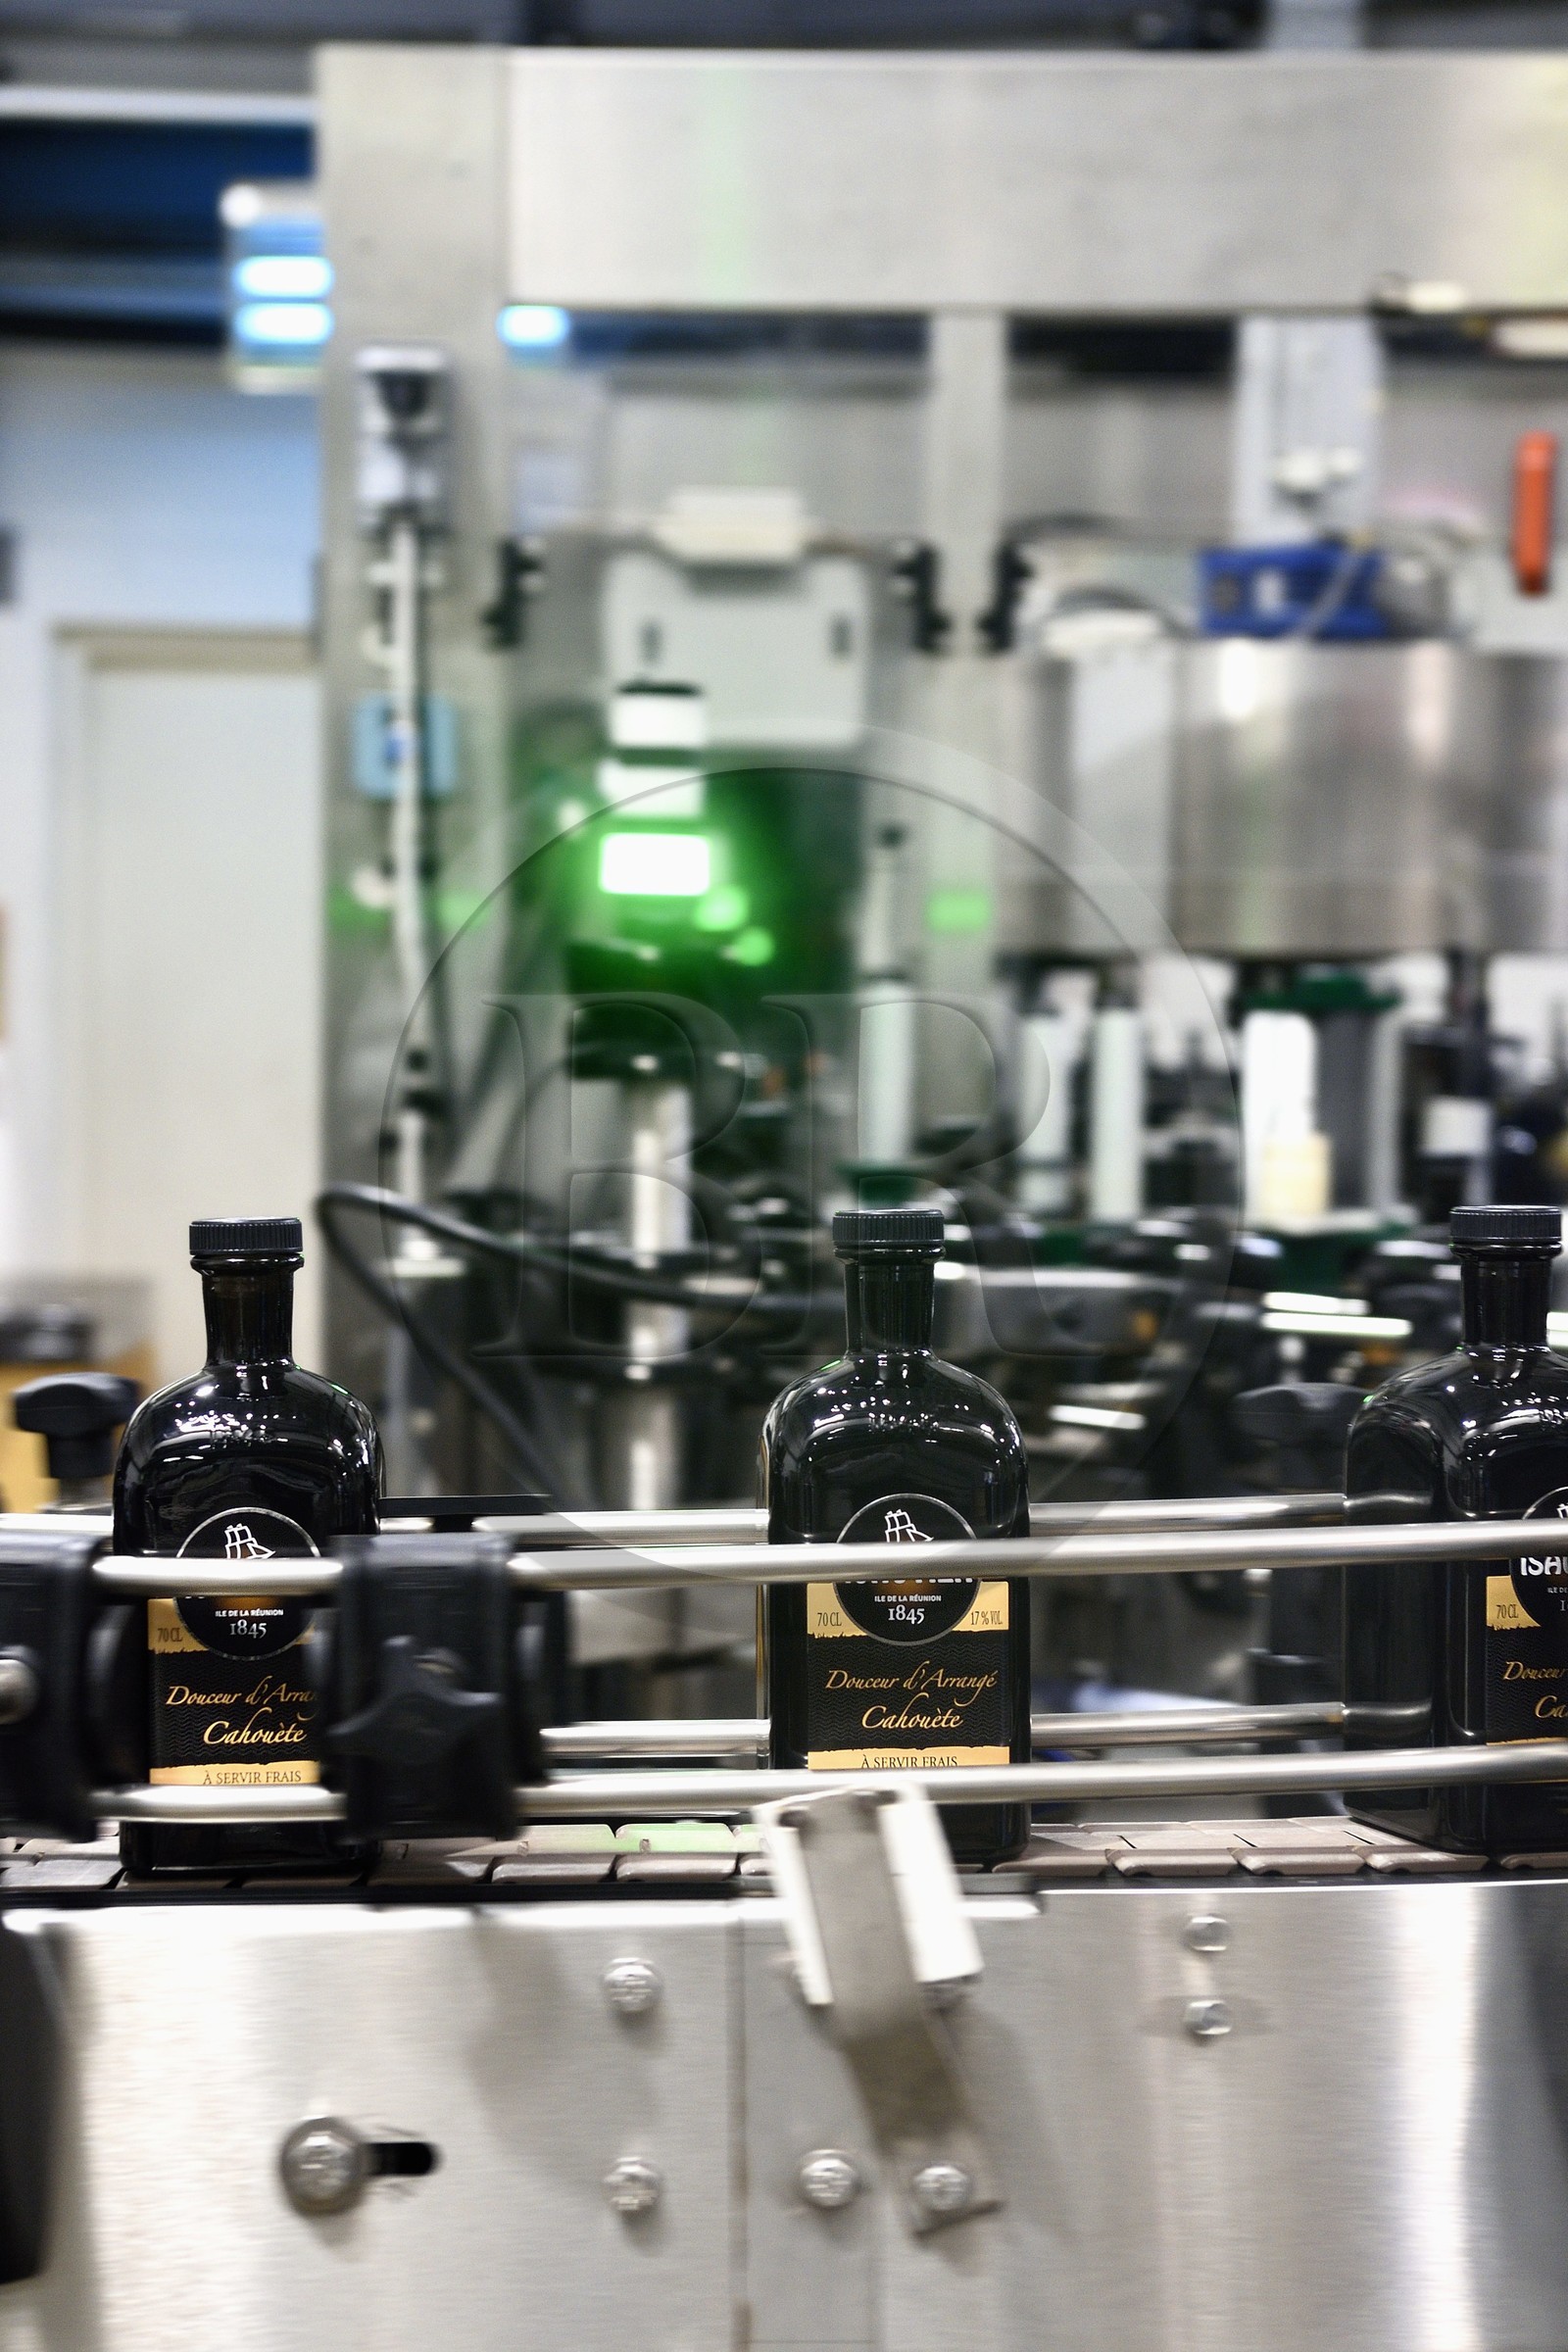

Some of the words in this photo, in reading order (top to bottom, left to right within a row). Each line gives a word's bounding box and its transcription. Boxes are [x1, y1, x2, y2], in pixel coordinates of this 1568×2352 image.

[909, 1593, 942, 1602] RÉUNION
[215, 1609, 227, 1618] ILE
[250, 1607, 284, 1617] RÉUNION
[888, 1604, 925, 1625] 1845
[229, 1619, 268, 1639] 1845
[825, 1669, 900, 1690] Douceur
[903, 1660, 999, 1707] d'Arrangé
[166, 1685, 242, 1705] Douceur
[861, 1692, 964, 1730] Cahouète
[203, 1706, 308, 1745] Cahouète
[860, 1754, 870, 1769] À
[873, 1756, 918, 1769] SERVIR
[922, 1755, 957, 1768] FRAIS
[203, 1770, 213, 1785] À
[217, 1772, 262, 1785] SERVIR
[266, 1770, 302, 1784] FRAIS
